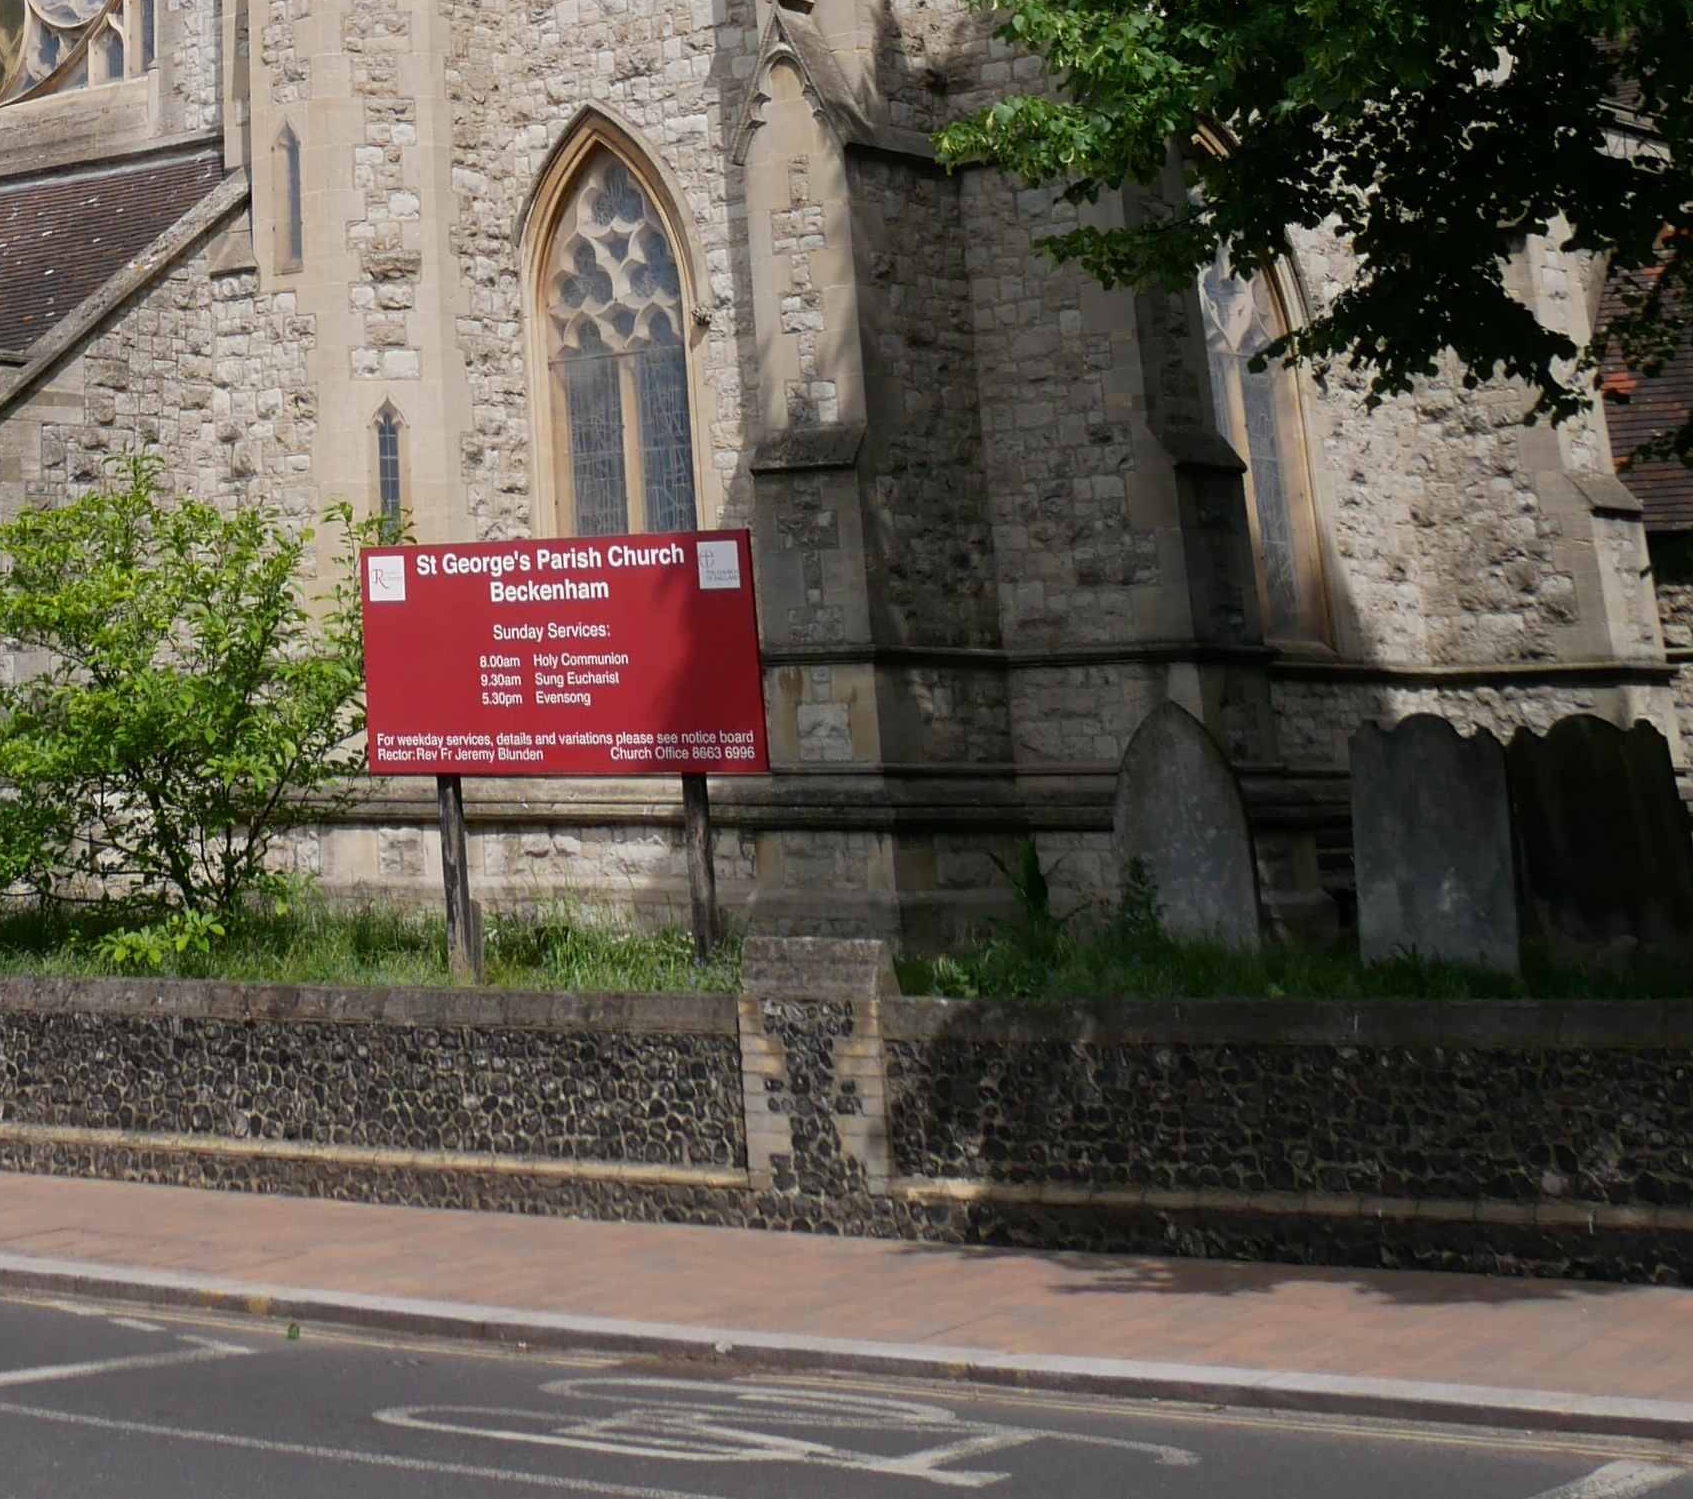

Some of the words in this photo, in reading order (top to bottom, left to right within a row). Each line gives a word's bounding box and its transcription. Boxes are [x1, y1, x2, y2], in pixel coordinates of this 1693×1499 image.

[416, 554, 437, 575] St
[442, 550, 531, 577] George's
[537, 547, 602, 570] Parish
[608, 543, 685, 567] Church
[490, 579, 609, 602] Beckenham
[493, 624, 544, 642] Sunday
[548, 621, 611, 638] Services:
[479, 655, 521, 668] 8.00am
[533, 653, 558, 669] Holy
[561, 652, 629, 666] Communion
[480, 673, 522, 687] 9.30am
[535, 672, 564, 688] Sung
[567, 671, 620, 685] Eucharist
[481, 692, 523, 707] 5.30pm
[535, 690, 591, 706] Evensong
[377, 733, 394, 746] For
[397, 733, 443, 748] weekday
[446, 732, 494, 747] services,
[496, 732, 533, 746] details
[535, 732, 556, 746] and
[558, 731, 613, 745] variations
[616, 731, 654, 747] please
[657, 733, 678, 744] see
[681, 730, 716, 744] notice
[719, 730, 754, 744] board
[440, 748, 453, 761] Fr
[455, 748, 495, 763] Jeremy
[498, 748, 544, 761] Blunden
[610, 747, 652, 760] Church
[655, 746, 689, 759] Office
[692, 746, 722, 759] 8663
[724, 746, 755, 759] 6996
